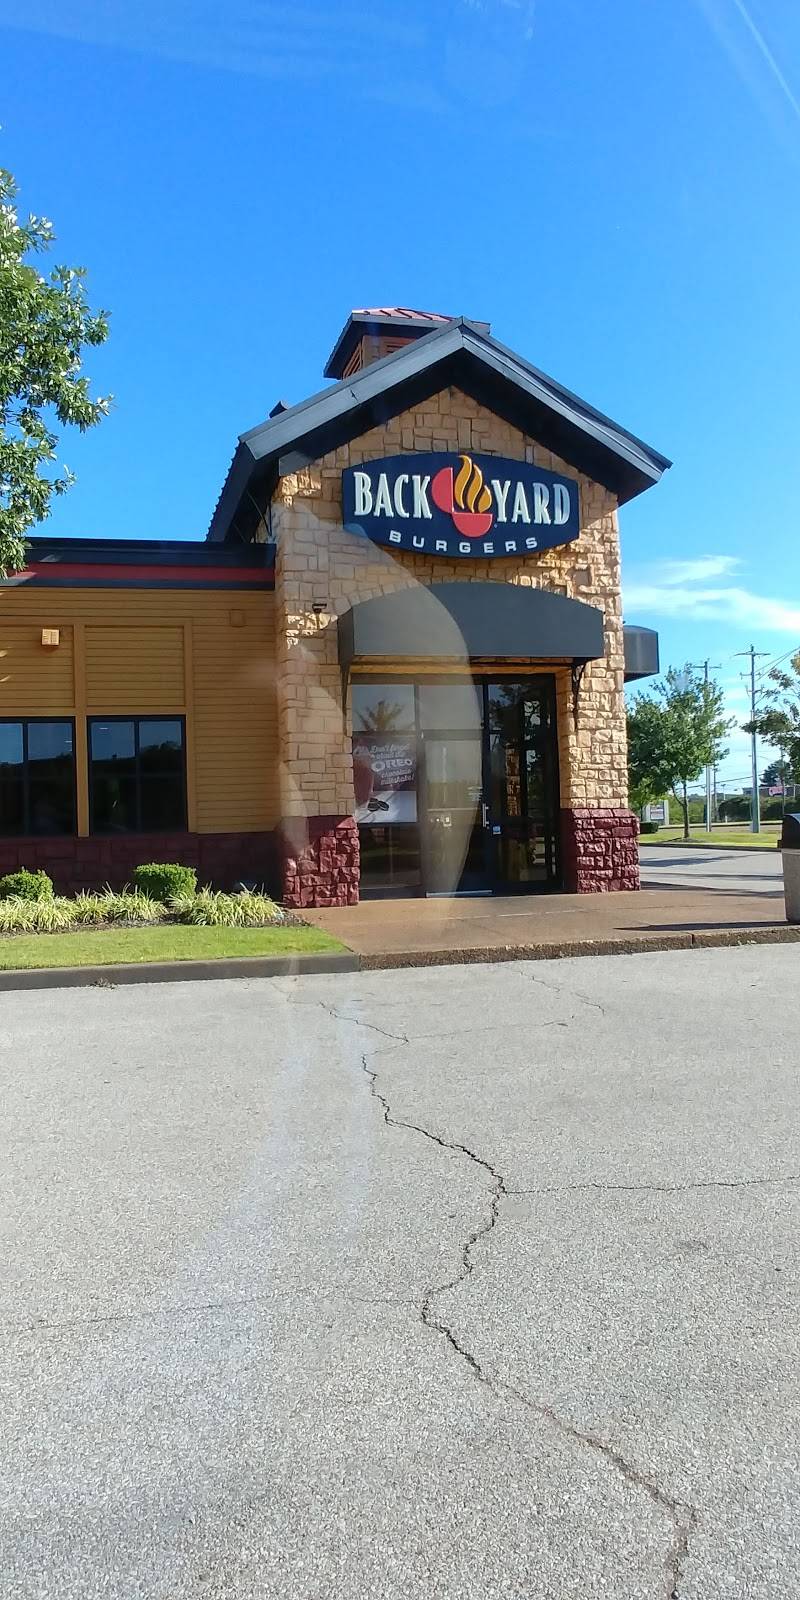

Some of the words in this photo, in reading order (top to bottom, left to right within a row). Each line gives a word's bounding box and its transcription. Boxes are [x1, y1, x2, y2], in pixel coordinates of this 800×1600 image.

[354, 472, 432, 519] BACK
[491, 480, 571, 525] YARD
[389, 531, 538, 554] BURGERS
[371, 759, 413, 772] OREO
